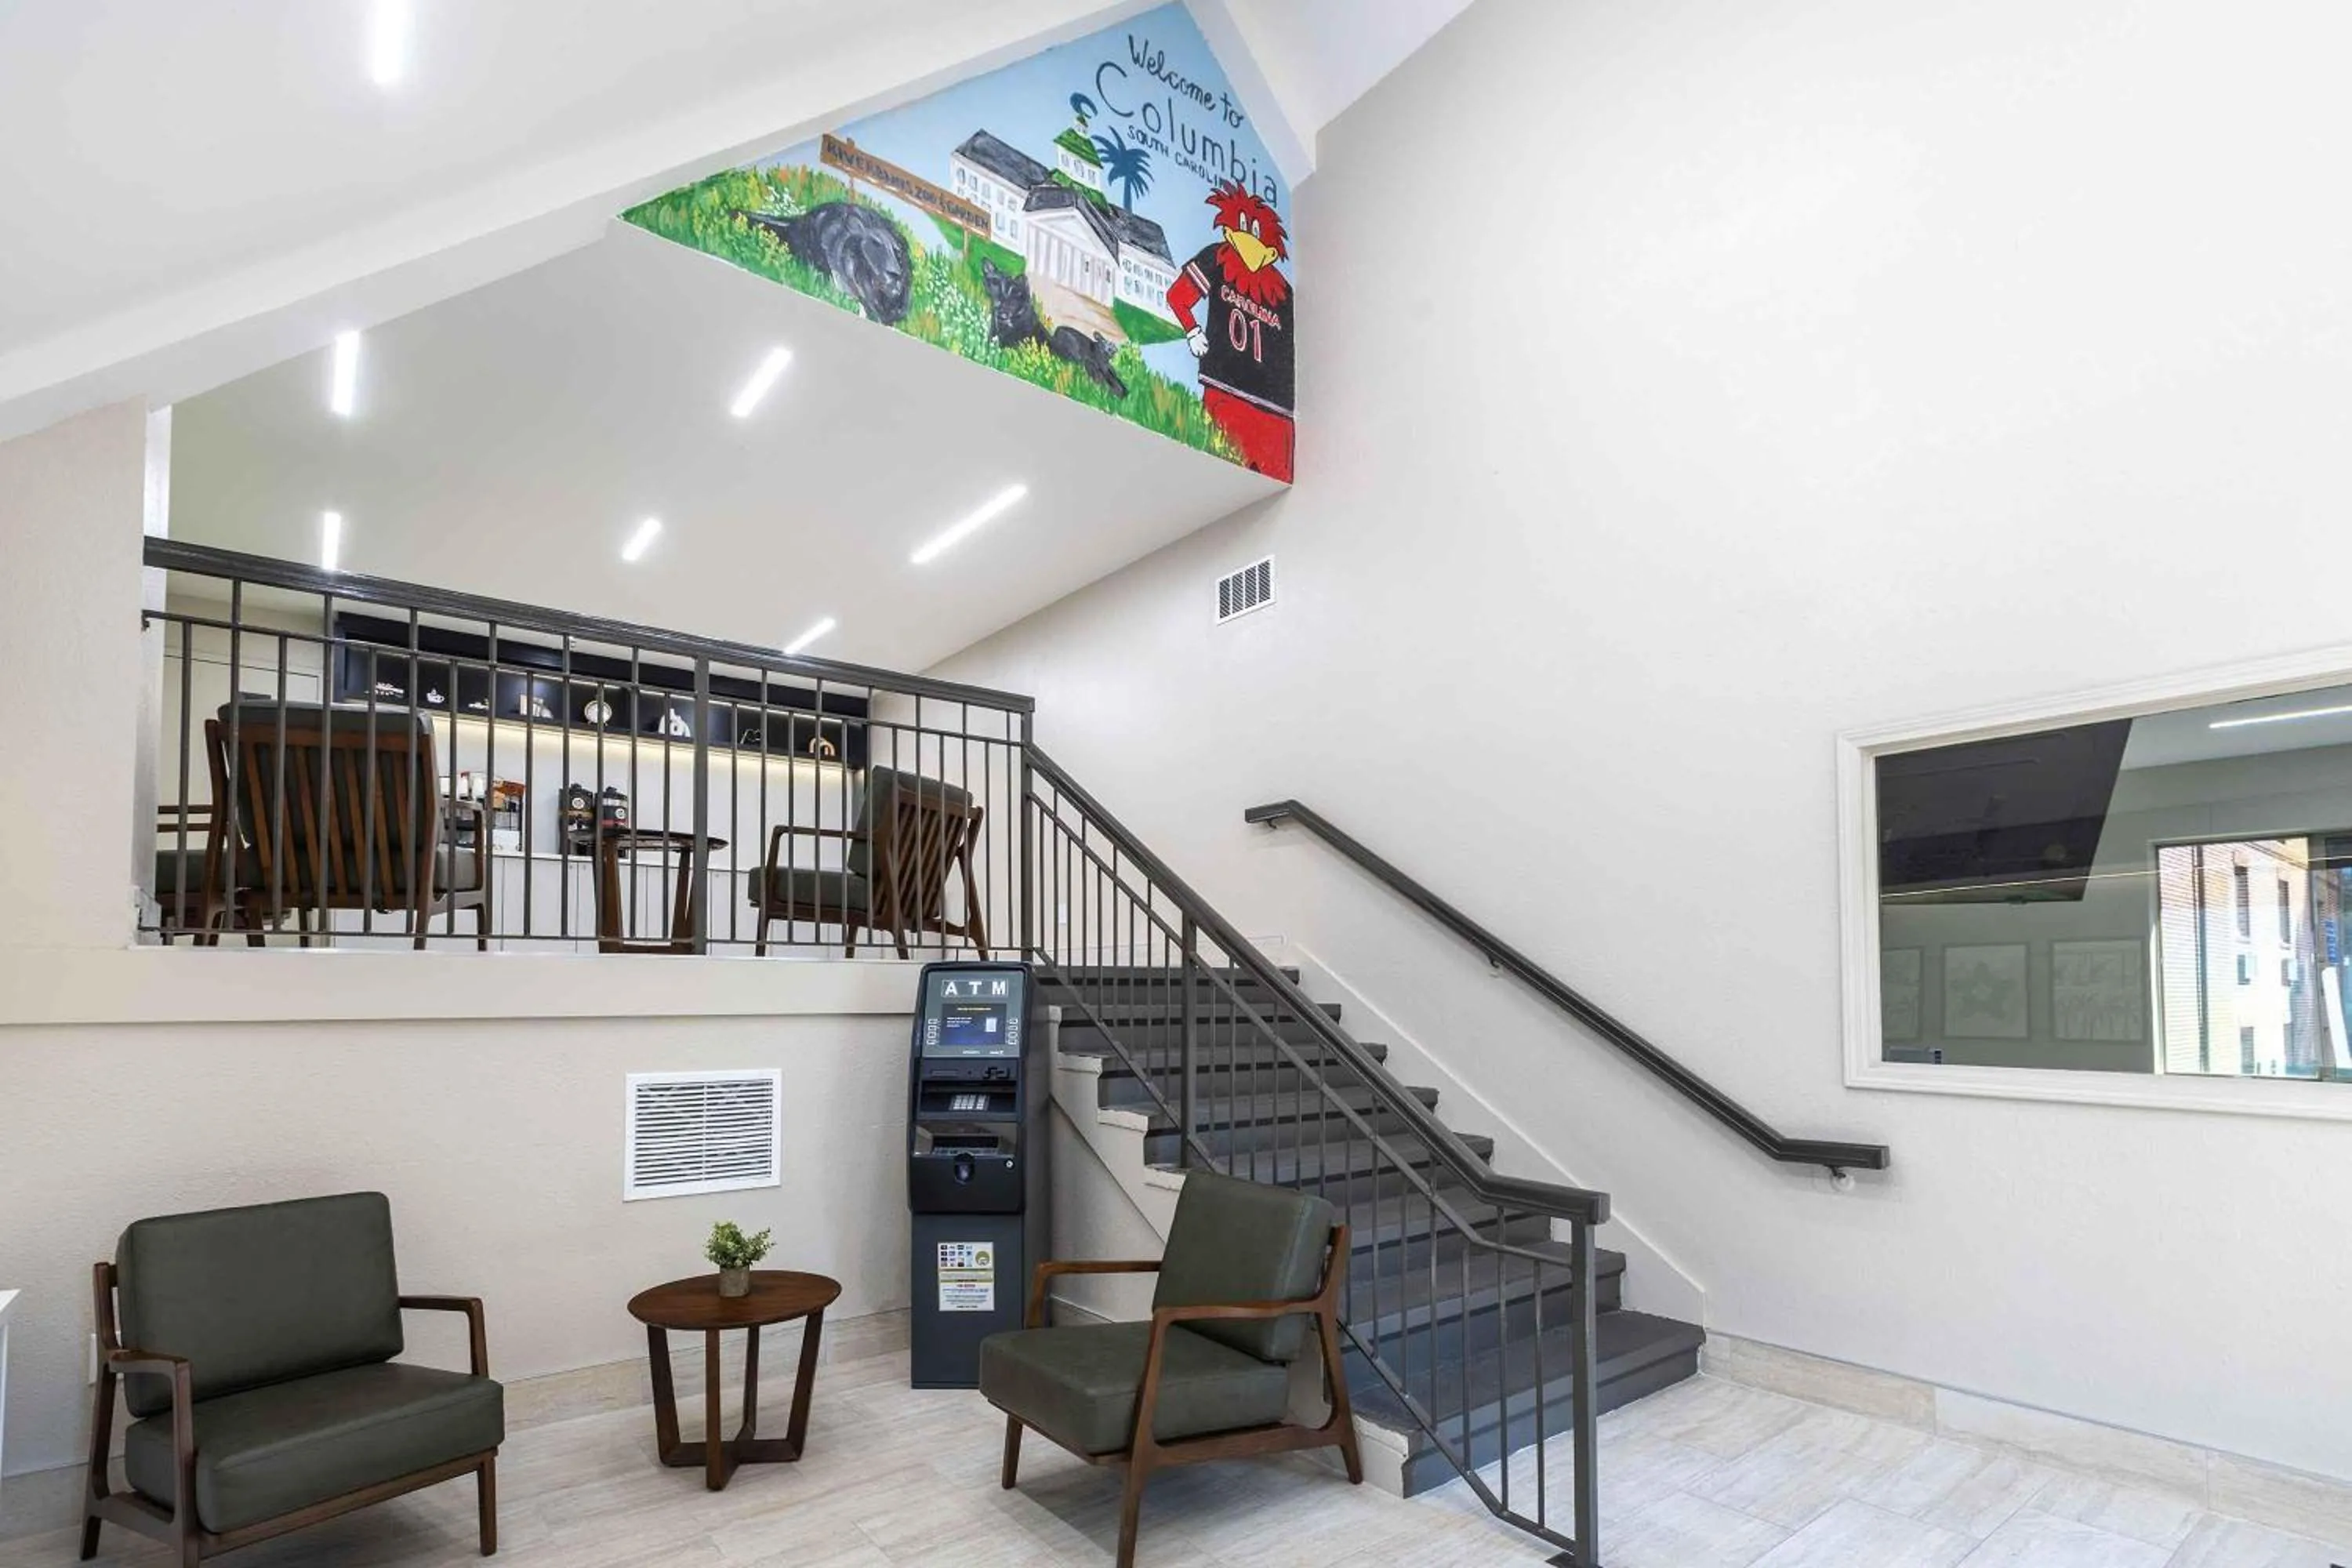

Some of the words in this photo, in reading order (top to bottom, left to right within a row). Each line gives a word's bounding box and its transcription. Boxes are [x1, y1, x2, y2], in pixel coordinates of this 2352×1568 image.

[1128, 34, 1216, 111] Welcome
[1220, 93, 1243, 129] to
[1096, 61, 1278, 209] Columbia
[1127, 125, 1169, 158] SOUTH
[1229, 308, 1263, 363] 01
[944, 981, 1007, 996] ATM
